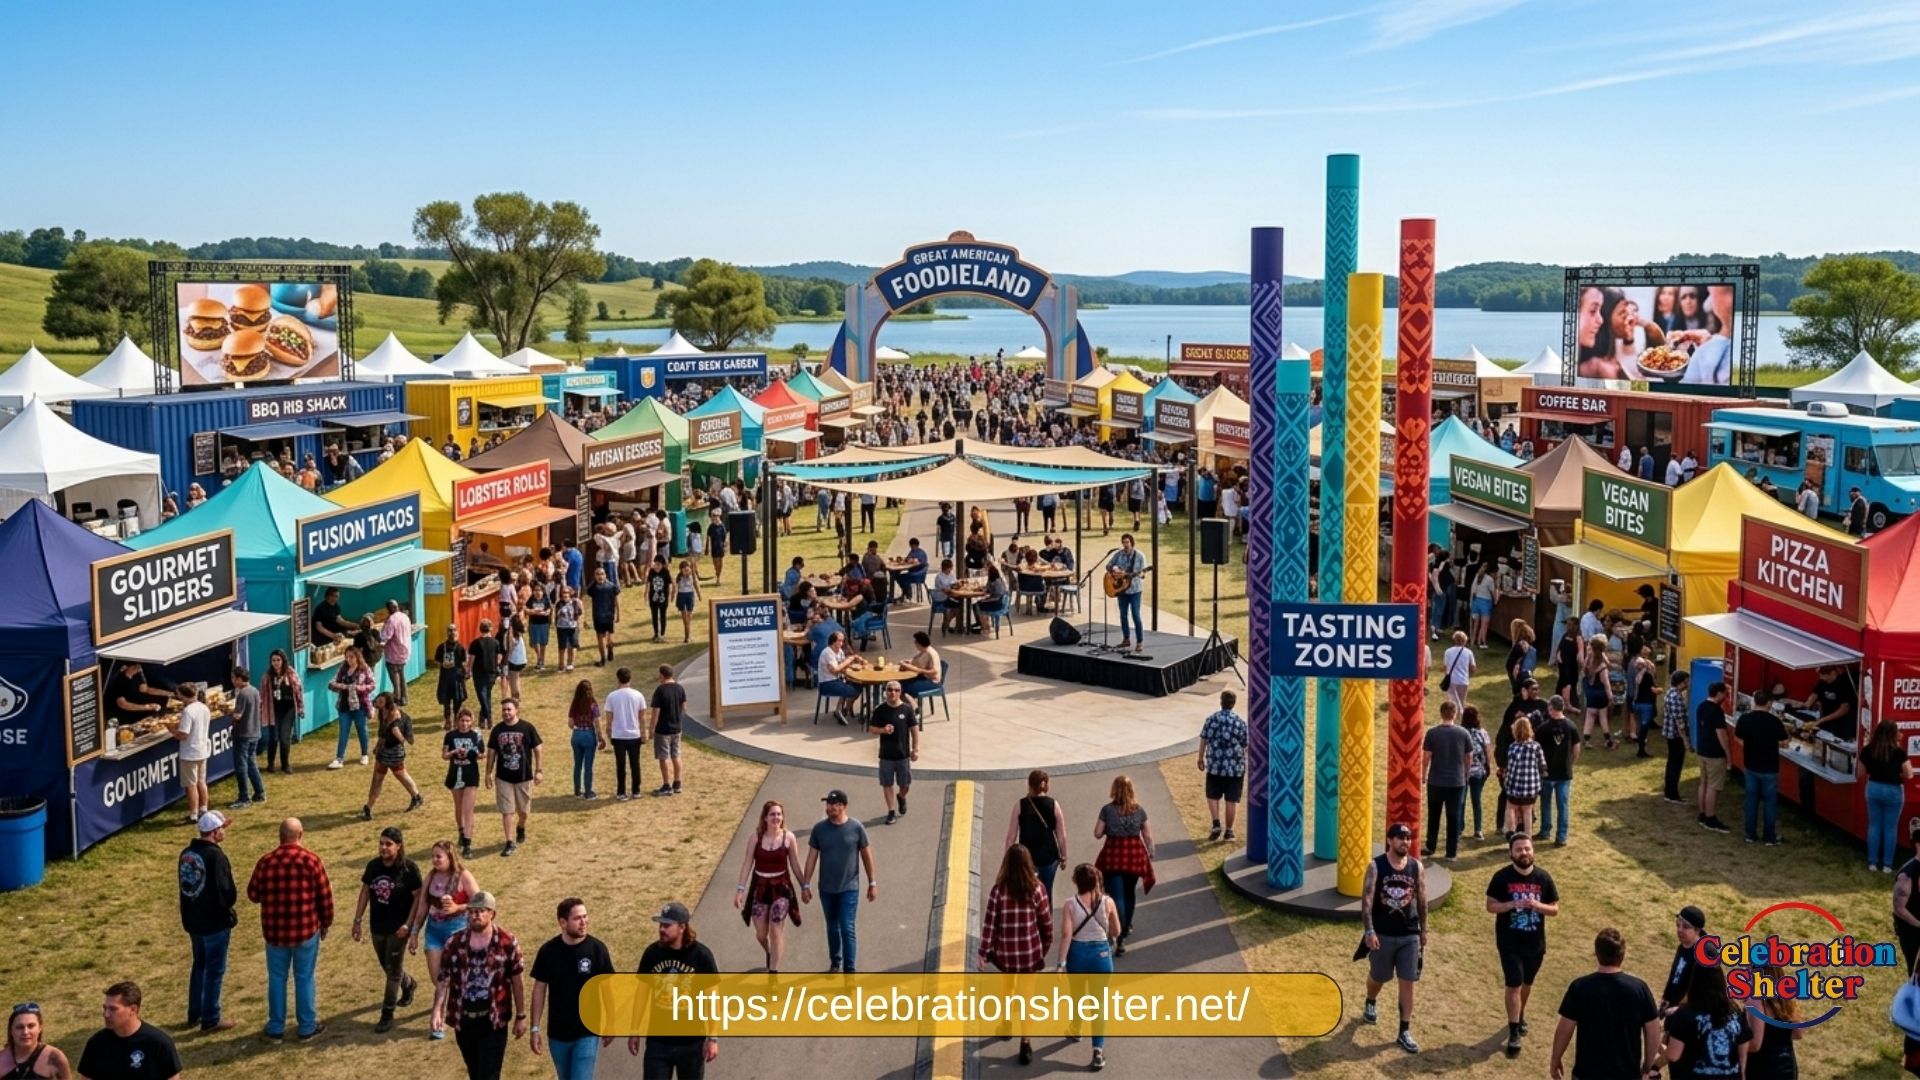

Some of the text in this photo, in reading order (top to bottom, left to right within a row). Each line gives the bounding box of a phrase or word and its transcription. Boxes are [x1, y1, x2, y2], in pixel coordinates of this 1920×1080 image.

[913, 248, 1010, 266] GREAT AMERICAN
[890, 263, 1031, 300] FOODIELAND
[251, 402, 280, 418] BBQ
[306, 395, 348, 413] SHACK
[1539, 394, 1580, 410] COFFEE
[459, 469, 547, 509] LOBSTER ROLLS
[1454, 465, 1492, 495] VEGAN
[1602, 480, 1650, 513] VEGAN
[308, 504, 415, 556] FUSION TACOS
[1605, 505, 1645, 535] BITES
[110, 543, 221, 596] GOURMET
[1771, 534, 1830, 574] PIZZA
[123, 573, 214, 622] SLIDERS
[1757, 558, 1844, 610] KITCHEN
[1282, 612, 1406, 639] TASTING
[1295, 642, 1393, 669] ZONES
[0, 728, 28, 745] SE
[102, 751, 179, 808] GOURMET
